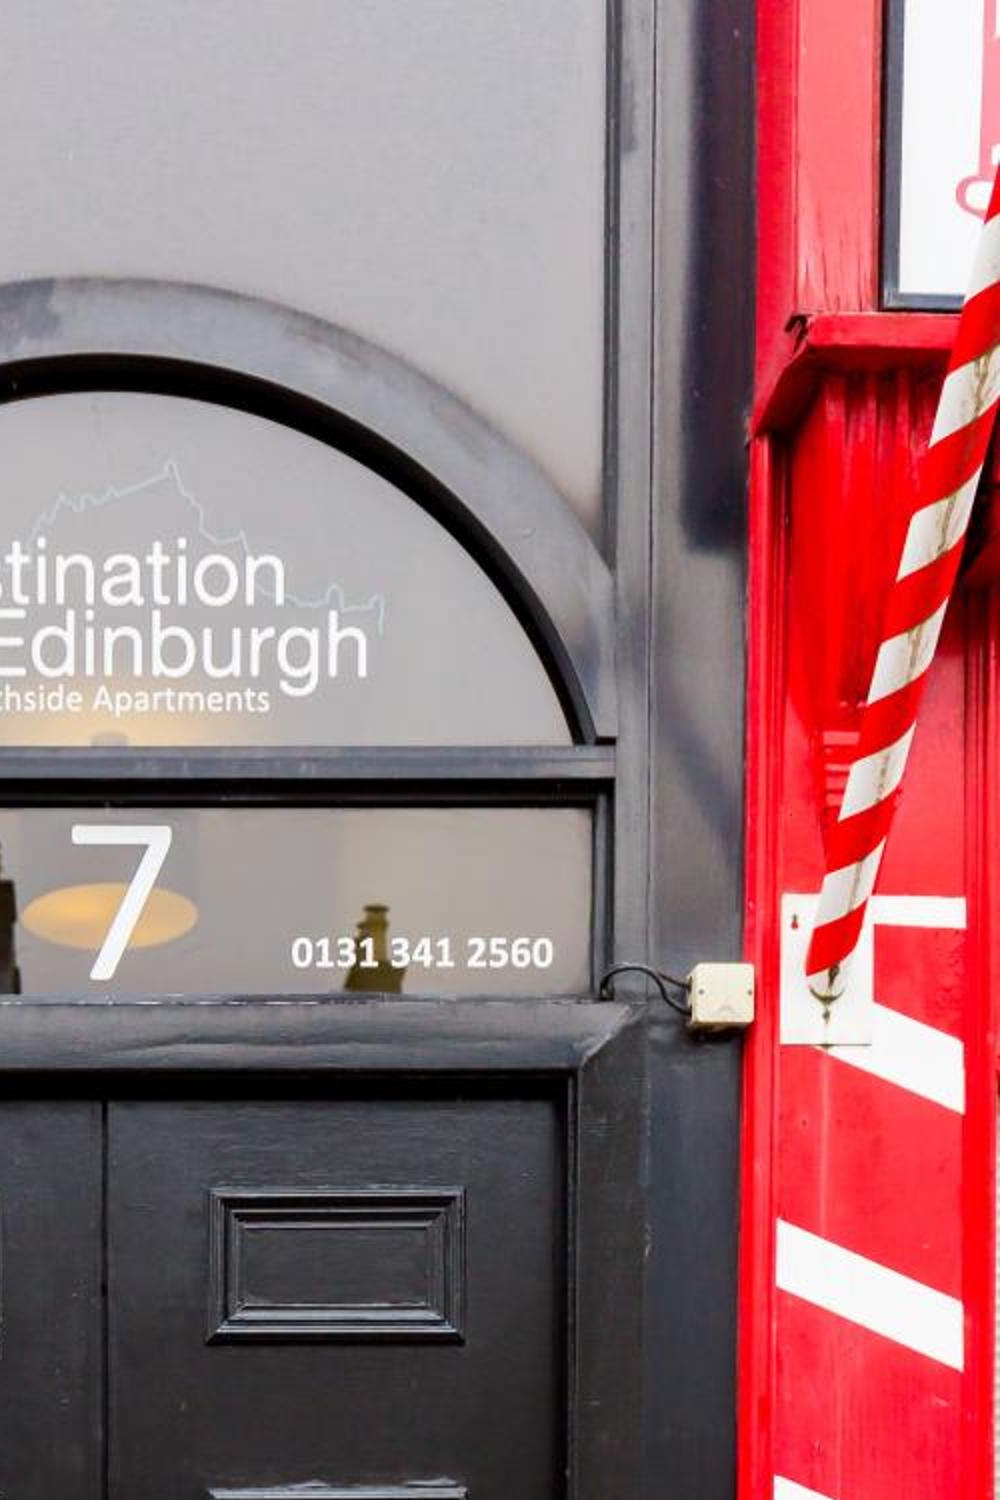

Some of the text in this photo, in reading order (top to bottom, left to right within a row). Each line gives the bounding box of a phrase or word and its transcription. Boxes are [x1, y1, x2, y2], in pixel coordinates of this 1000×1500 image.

[92, 684, 271, 717] Apartments
[71, 824, 173, 981] 7
[291, 936, 555, 969] 0131 341 2560
